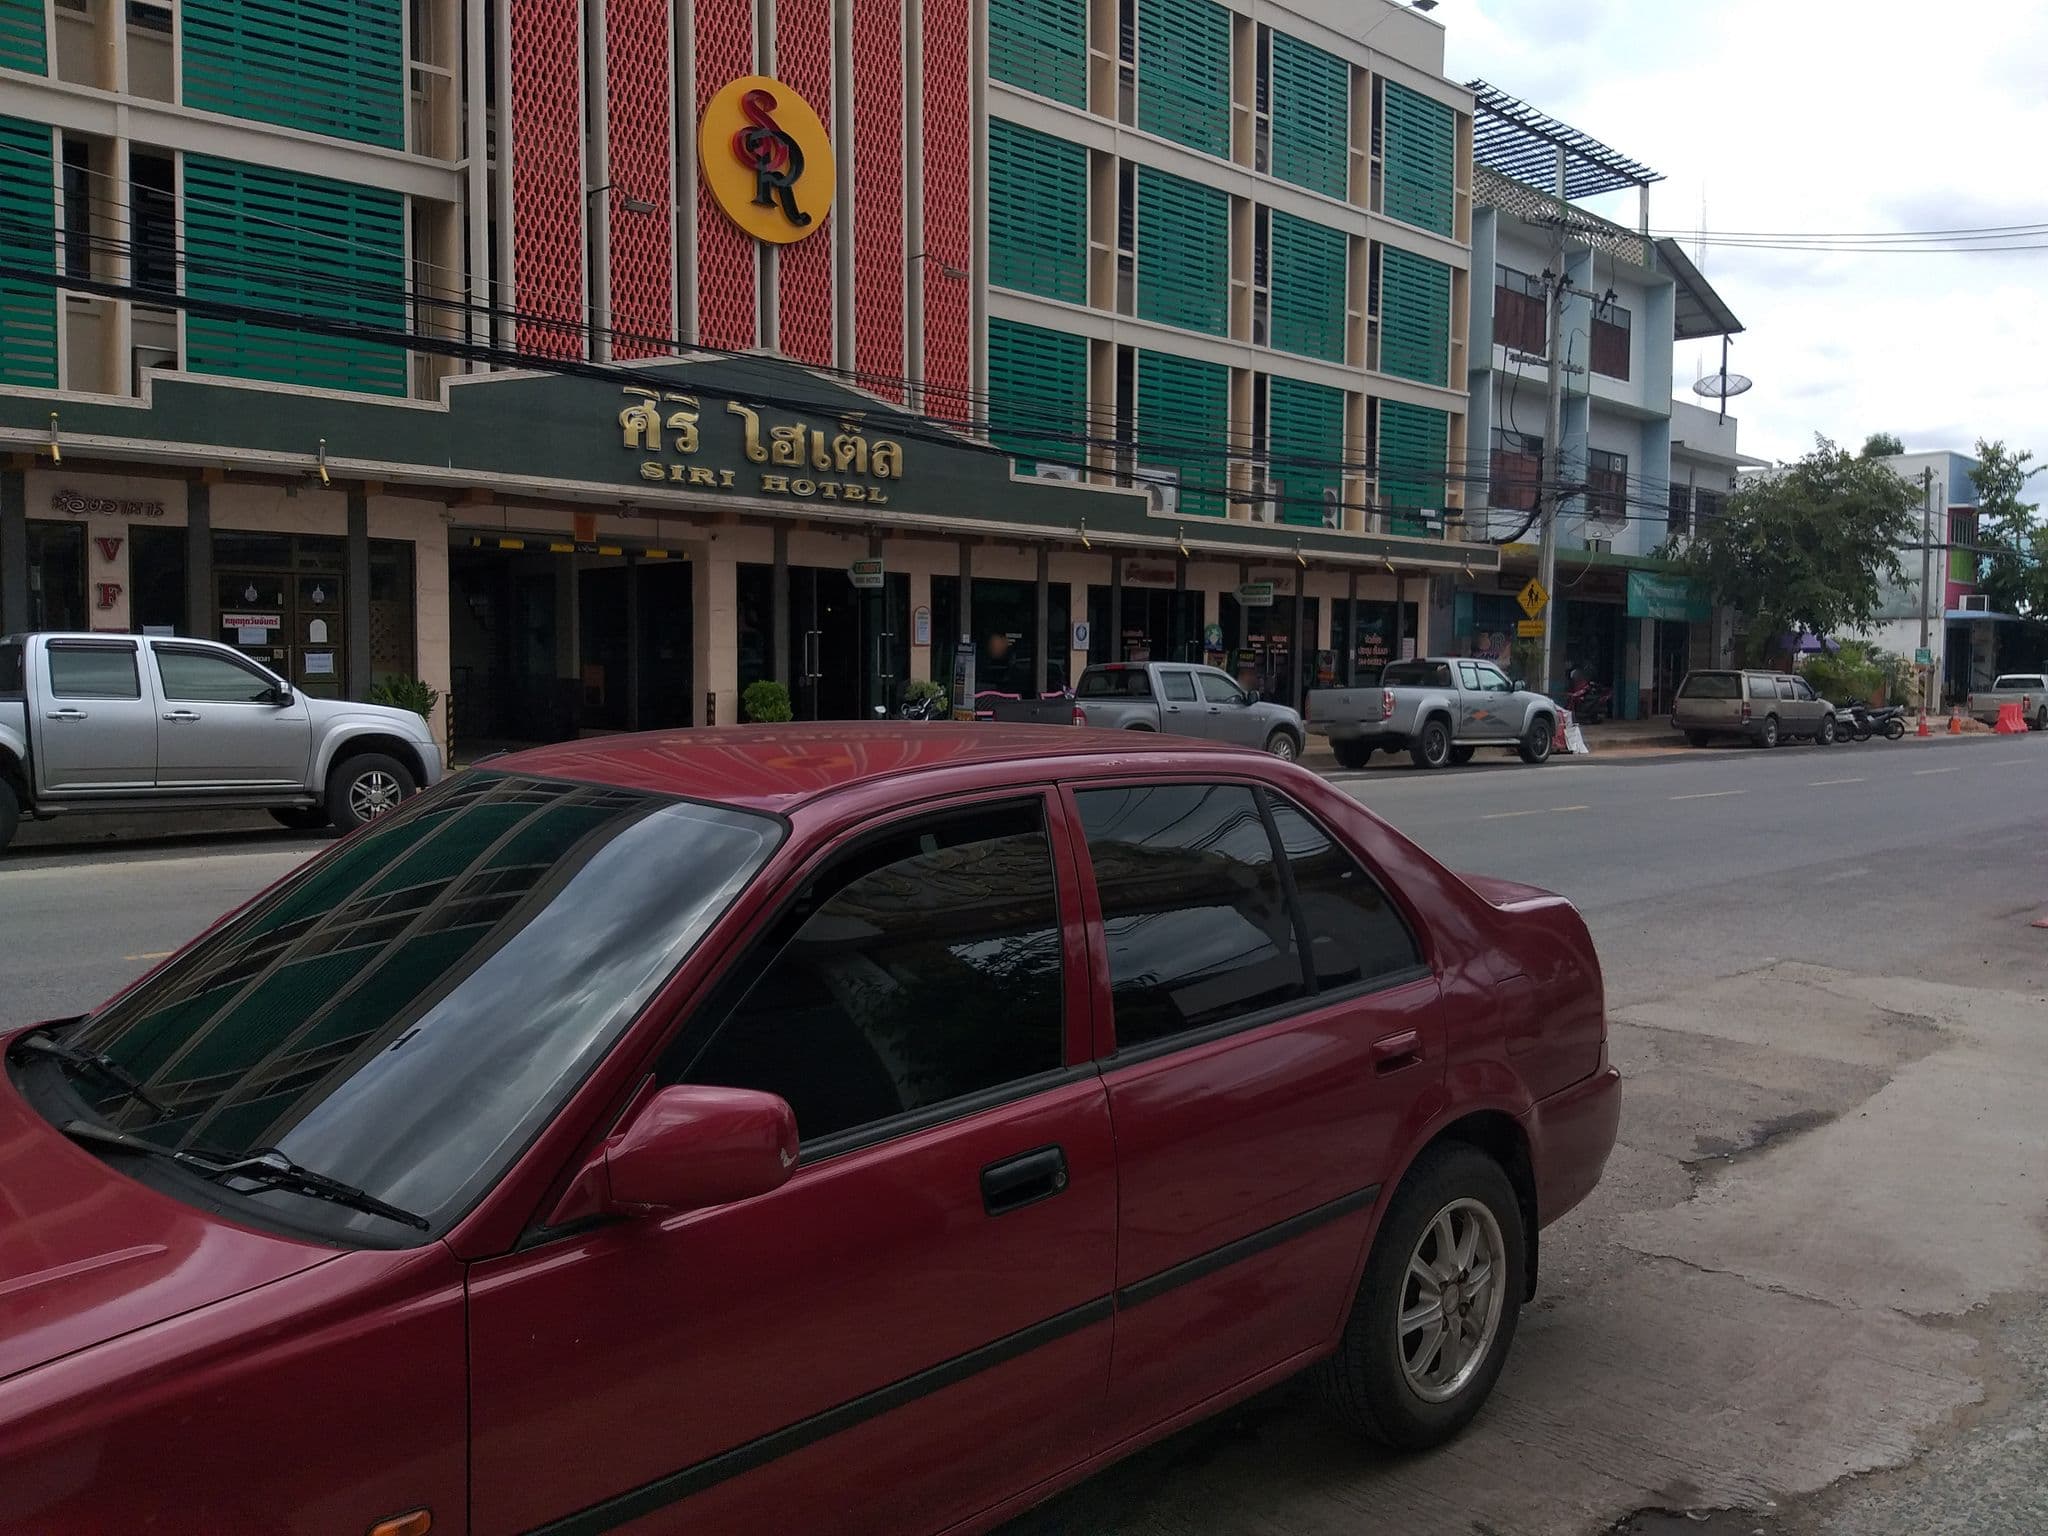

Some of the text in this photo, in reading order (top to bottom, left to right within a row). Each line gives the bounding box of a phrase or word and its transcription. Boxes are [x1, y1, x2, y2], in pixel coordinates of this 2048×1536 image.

[618, 386, 700, 454] ศิริ
[640, 461, 889, 504] SIRI HOTEL
